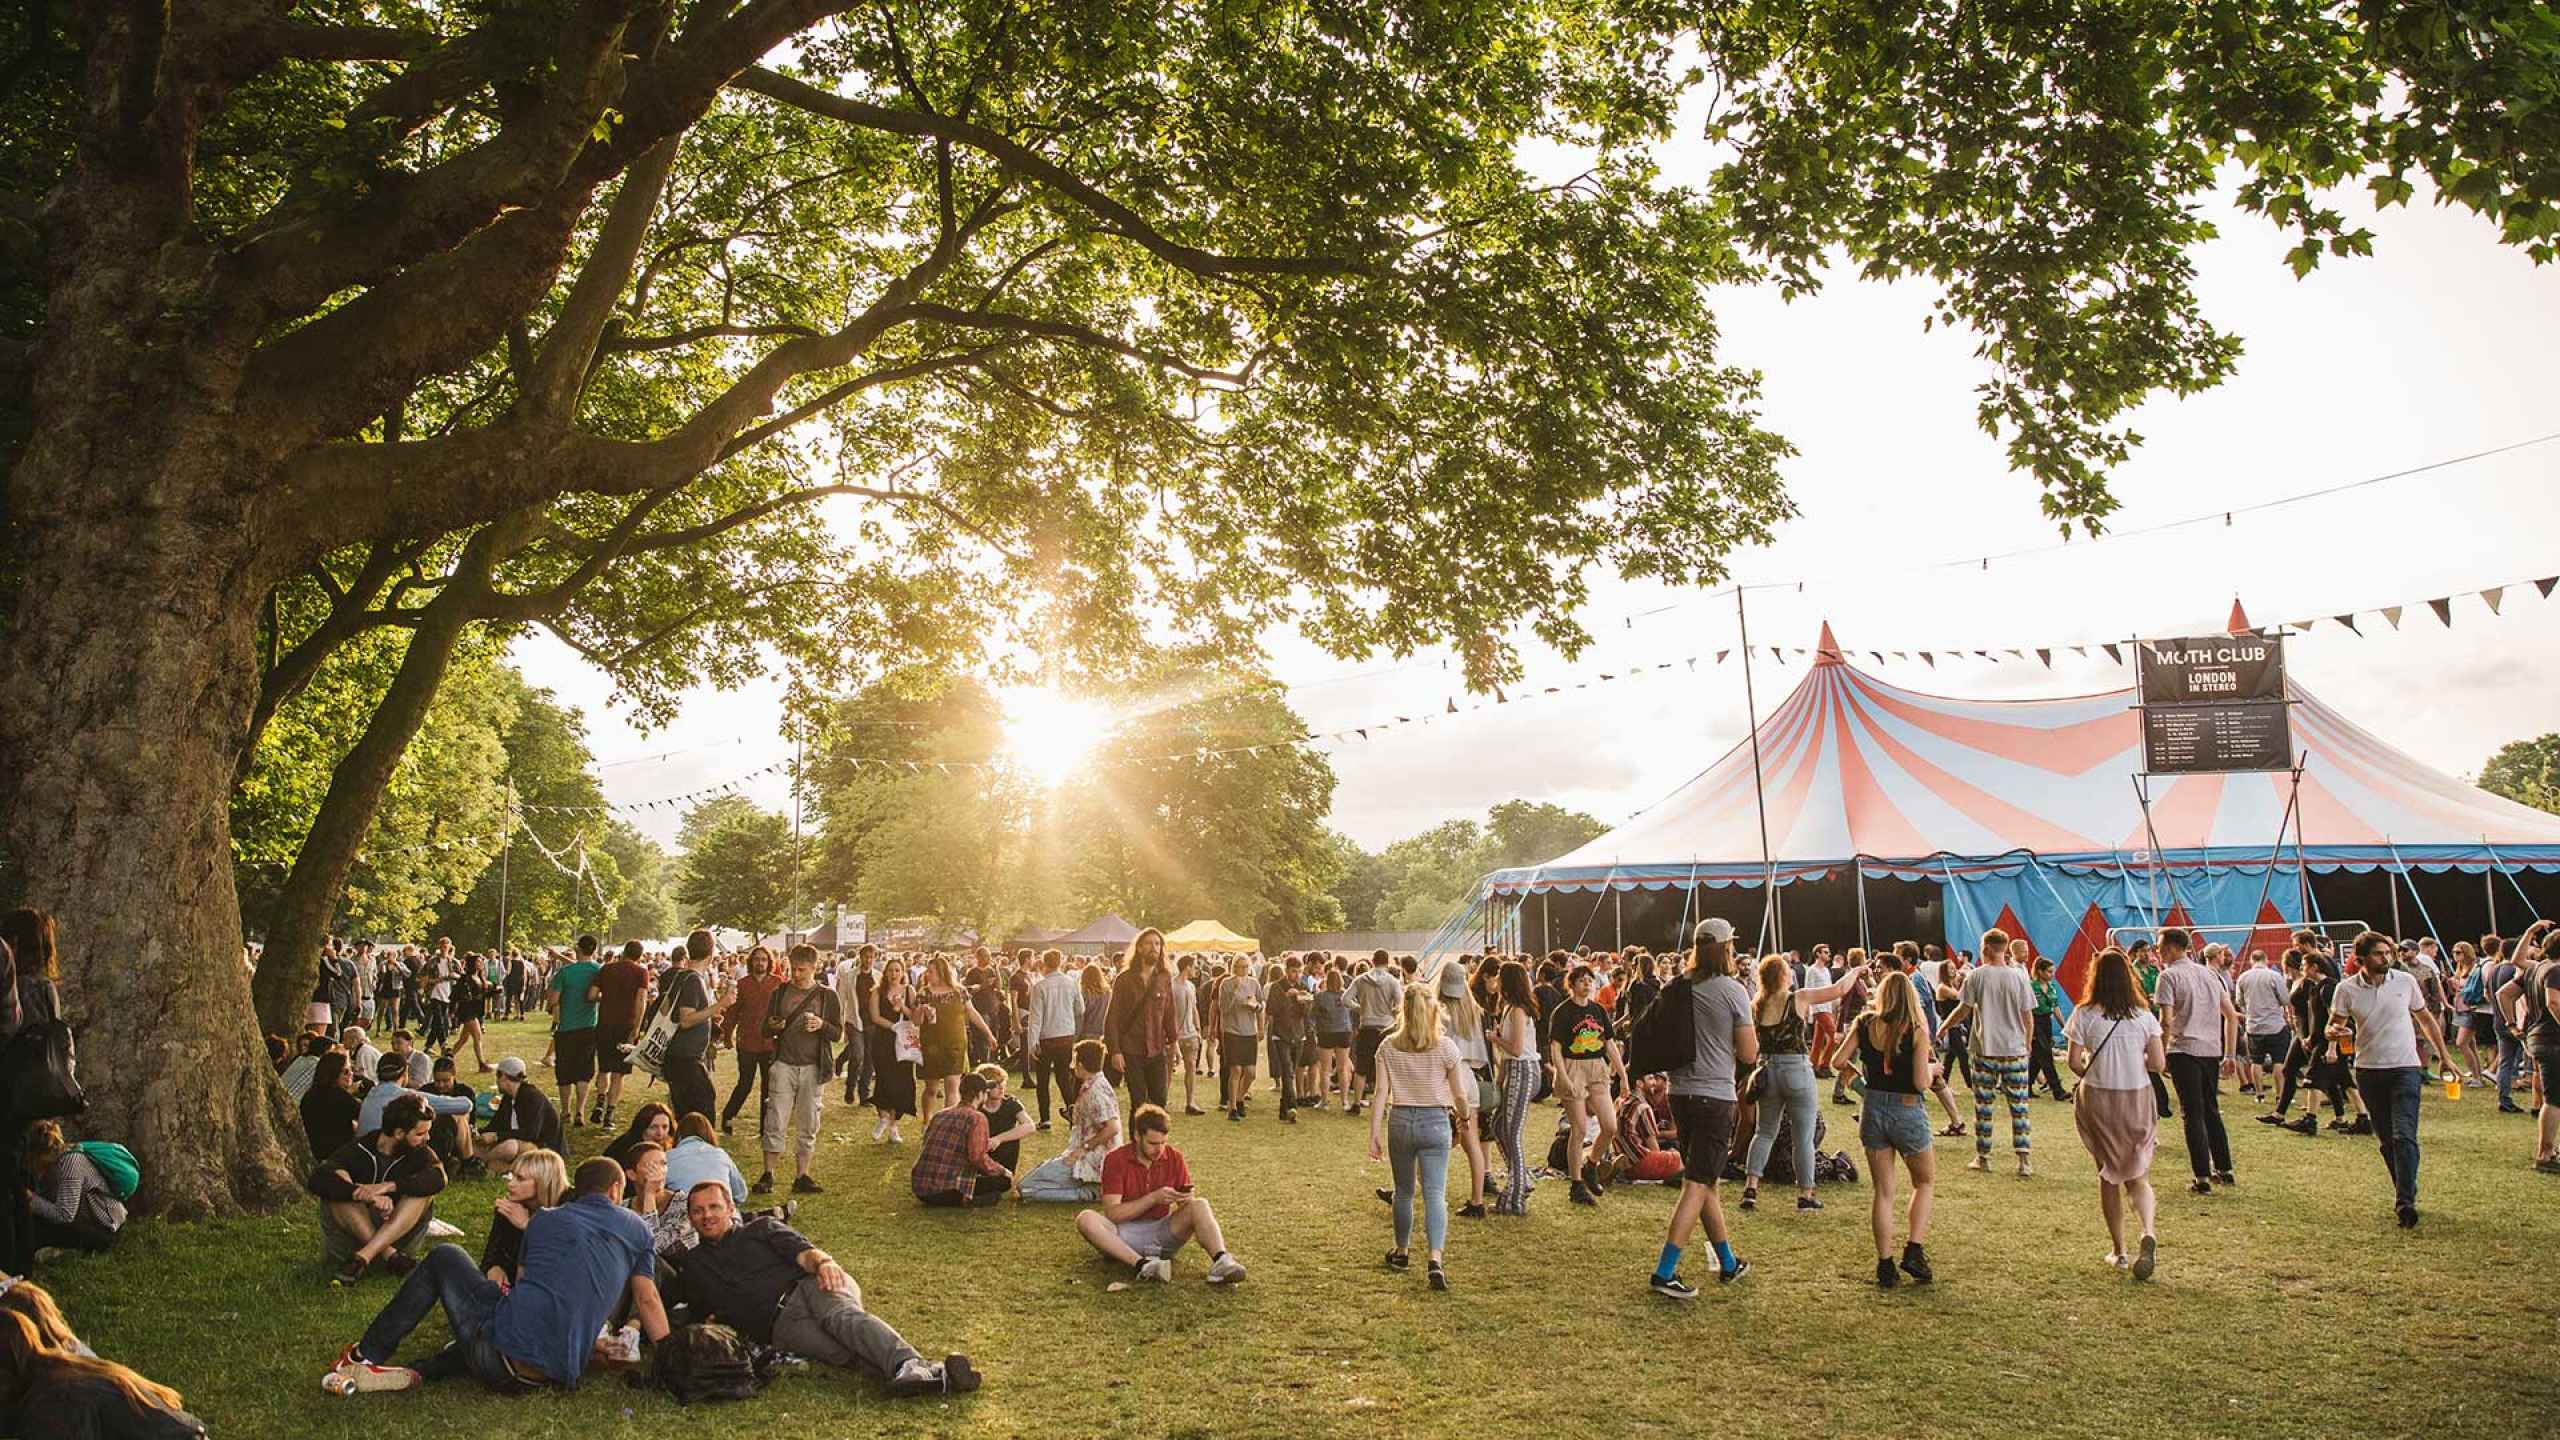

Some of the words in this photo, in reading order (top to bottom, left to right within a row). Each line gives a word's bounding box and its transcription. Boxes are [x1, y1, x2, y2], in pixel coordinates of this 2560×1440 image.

[2156, 648, 2213, 665] MOTH
[2216, 647, 2266, 663] CLUB
[2188, 671, 2237, 684] LONDON
[2189, 684, 2201, 693] IN
[2202, 683, 2237, 692] STEREO
